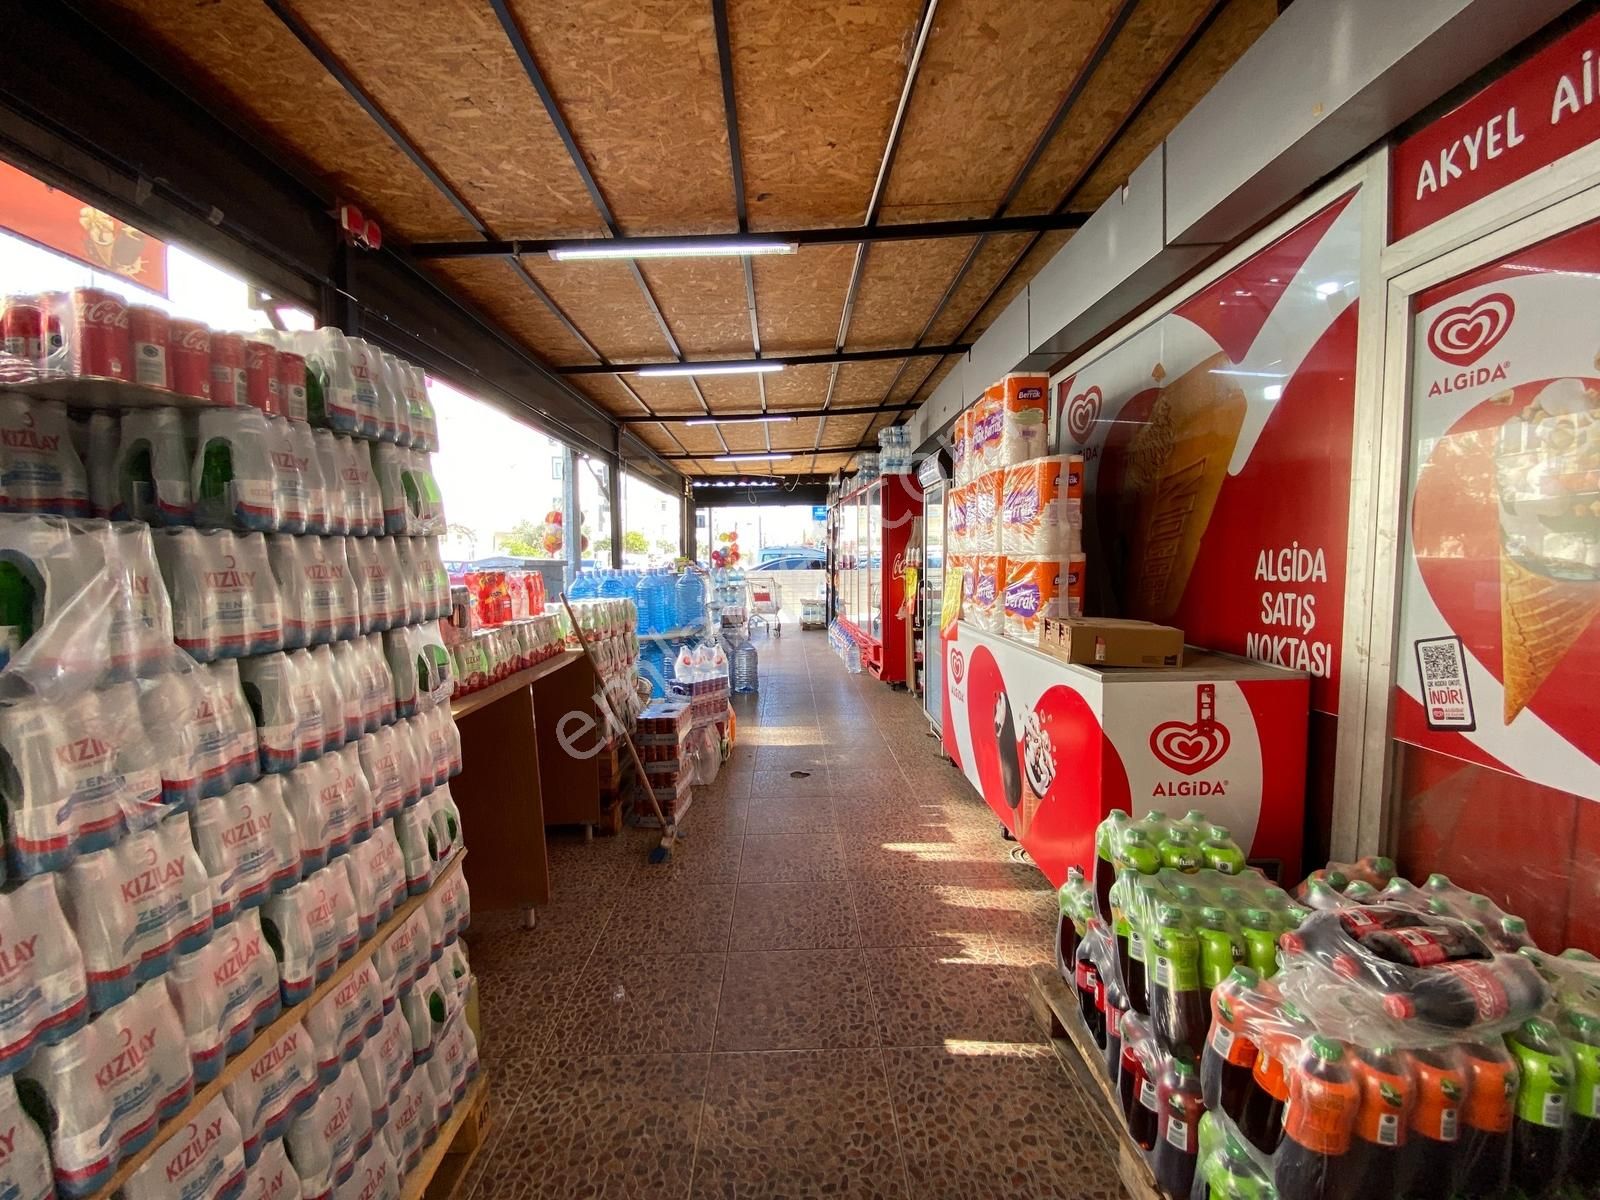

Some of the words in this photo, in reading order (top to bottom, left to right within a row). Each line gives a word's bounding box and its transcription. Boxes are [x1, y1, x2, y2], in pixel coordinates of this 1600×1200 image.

[1416, 107, 1524, 200] AKYEL
[1551, 50, 1600, 125] Aİ
[1255, 541, 1327, 583] ALGİDA
[1261, 592, 1315, 635] SATIŞ
[1246, 632, 1332, 679] NOKTASI
[222, 813, 272, 848] KIZILAY
[121, 856, 186, 901] KIZILAY
[213, 937, 263, 985] KIZILAY
[94, 1028, 157, 1088] KIZILAY
[251, 1034, 298, 1081] KIZILAY
[166, 1118, 222, 1182] KIZILAY
